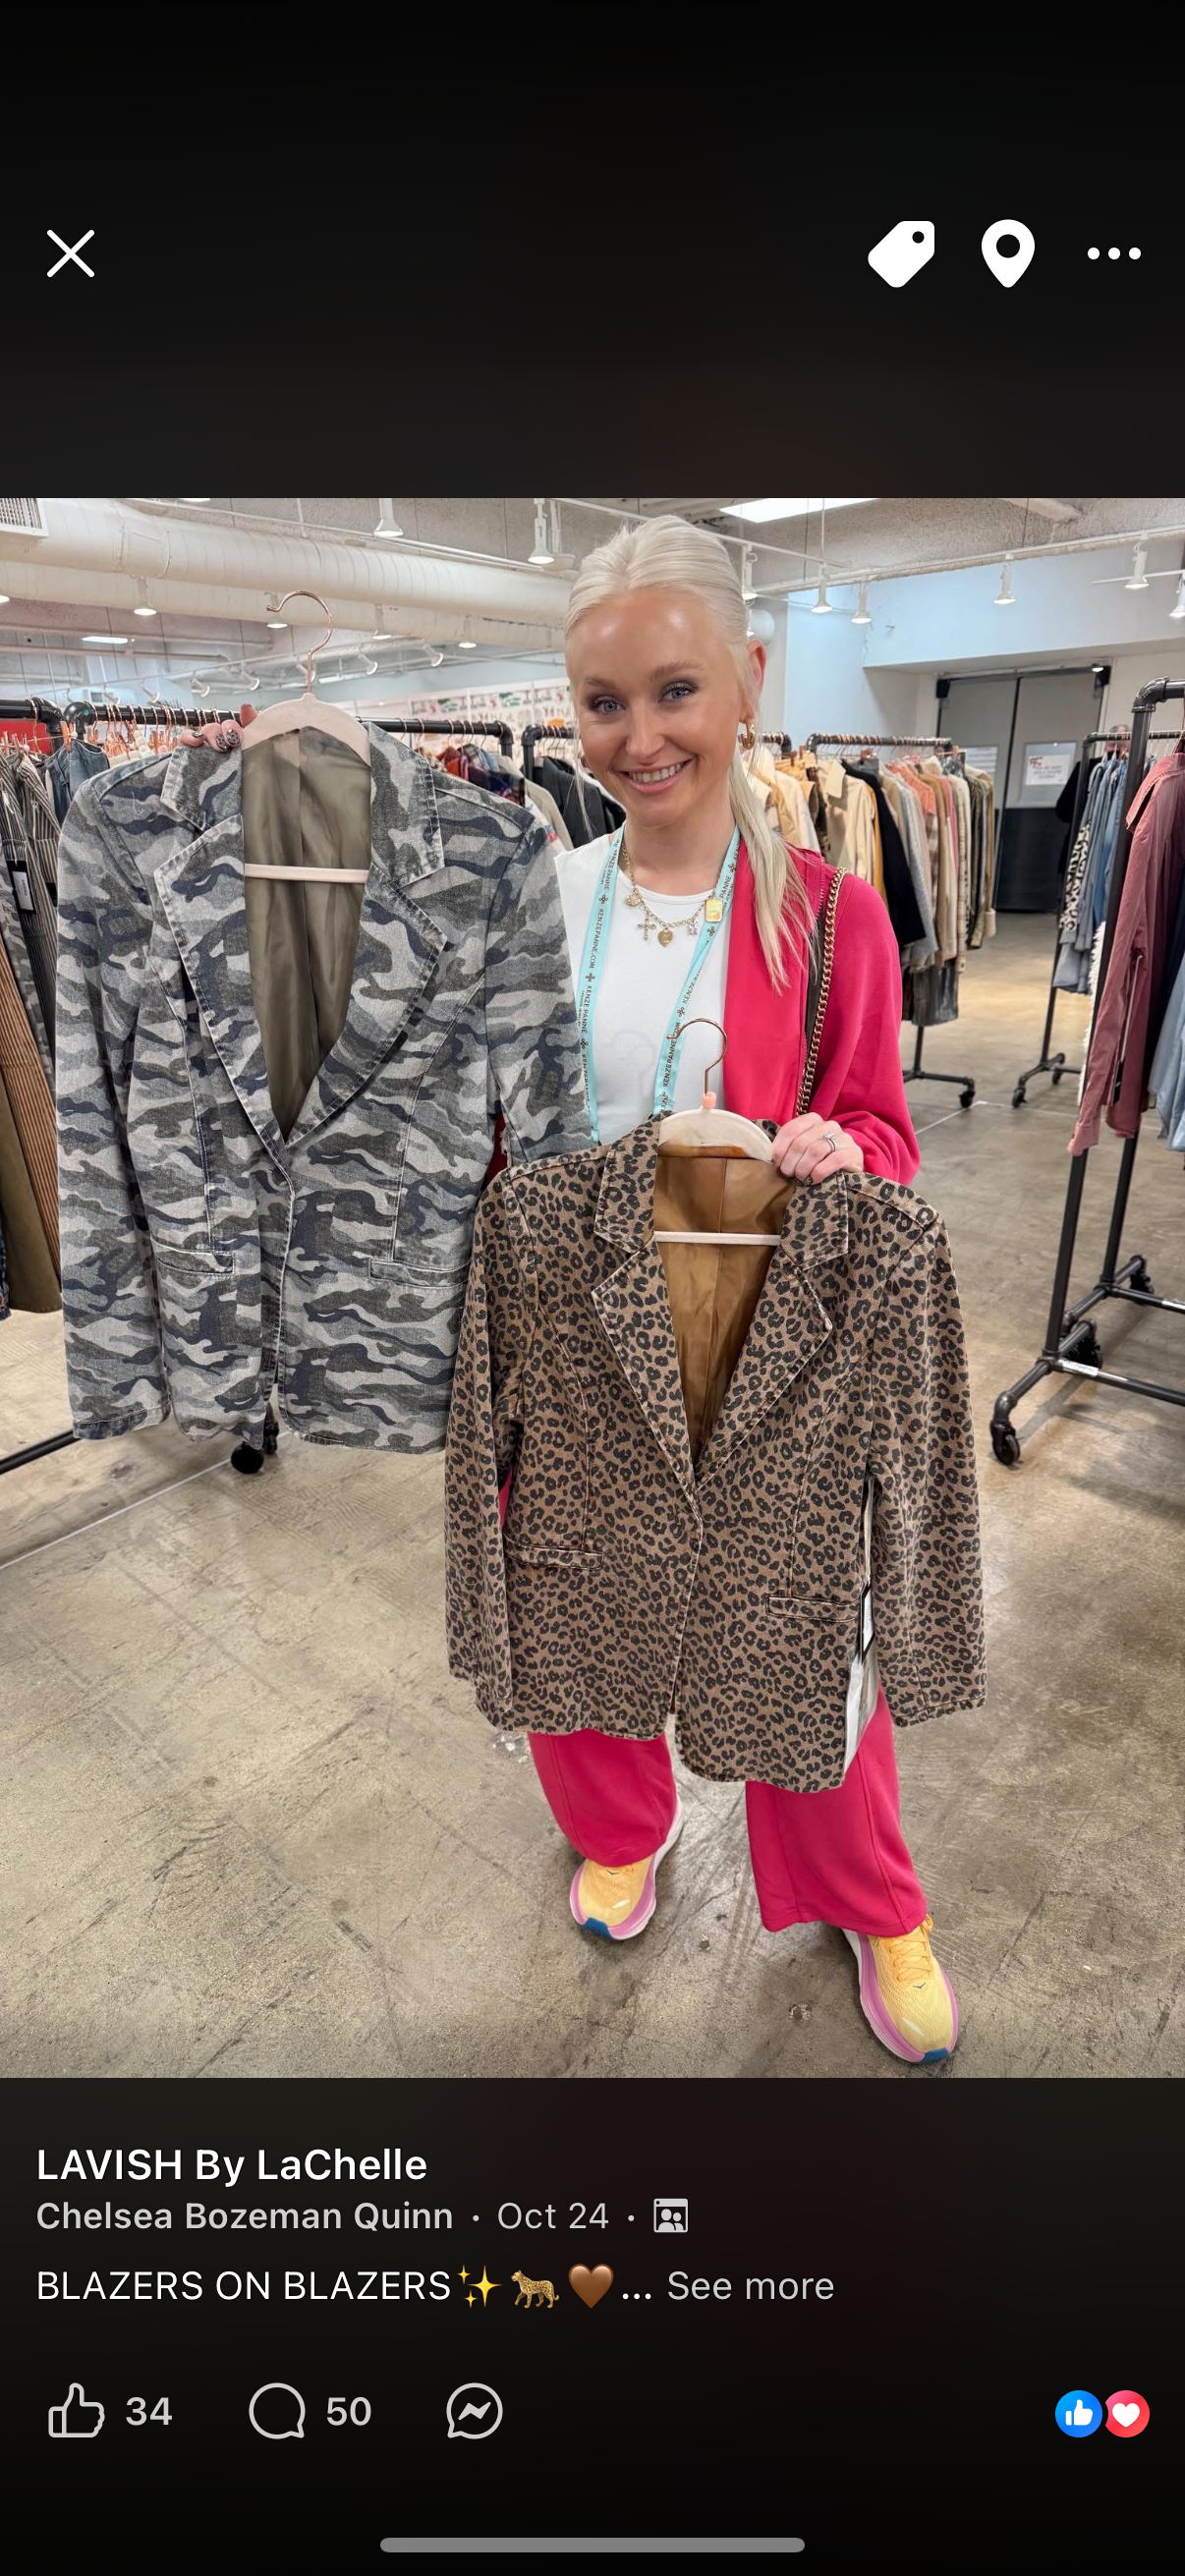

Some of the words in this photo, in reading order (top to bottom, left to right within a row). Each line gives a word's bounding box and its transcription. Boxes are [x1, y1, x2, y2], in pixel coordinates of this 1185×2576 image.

[719, 874, 732, 899] PANNE
[589, 908, 604, 969] KENZEPANNE.COM
[584, 985, 592, 1008] KENZE
[581, 1009, 590, 1034] PANNE
[662, 1022, 681, 1087] KENZEPANNEOM
